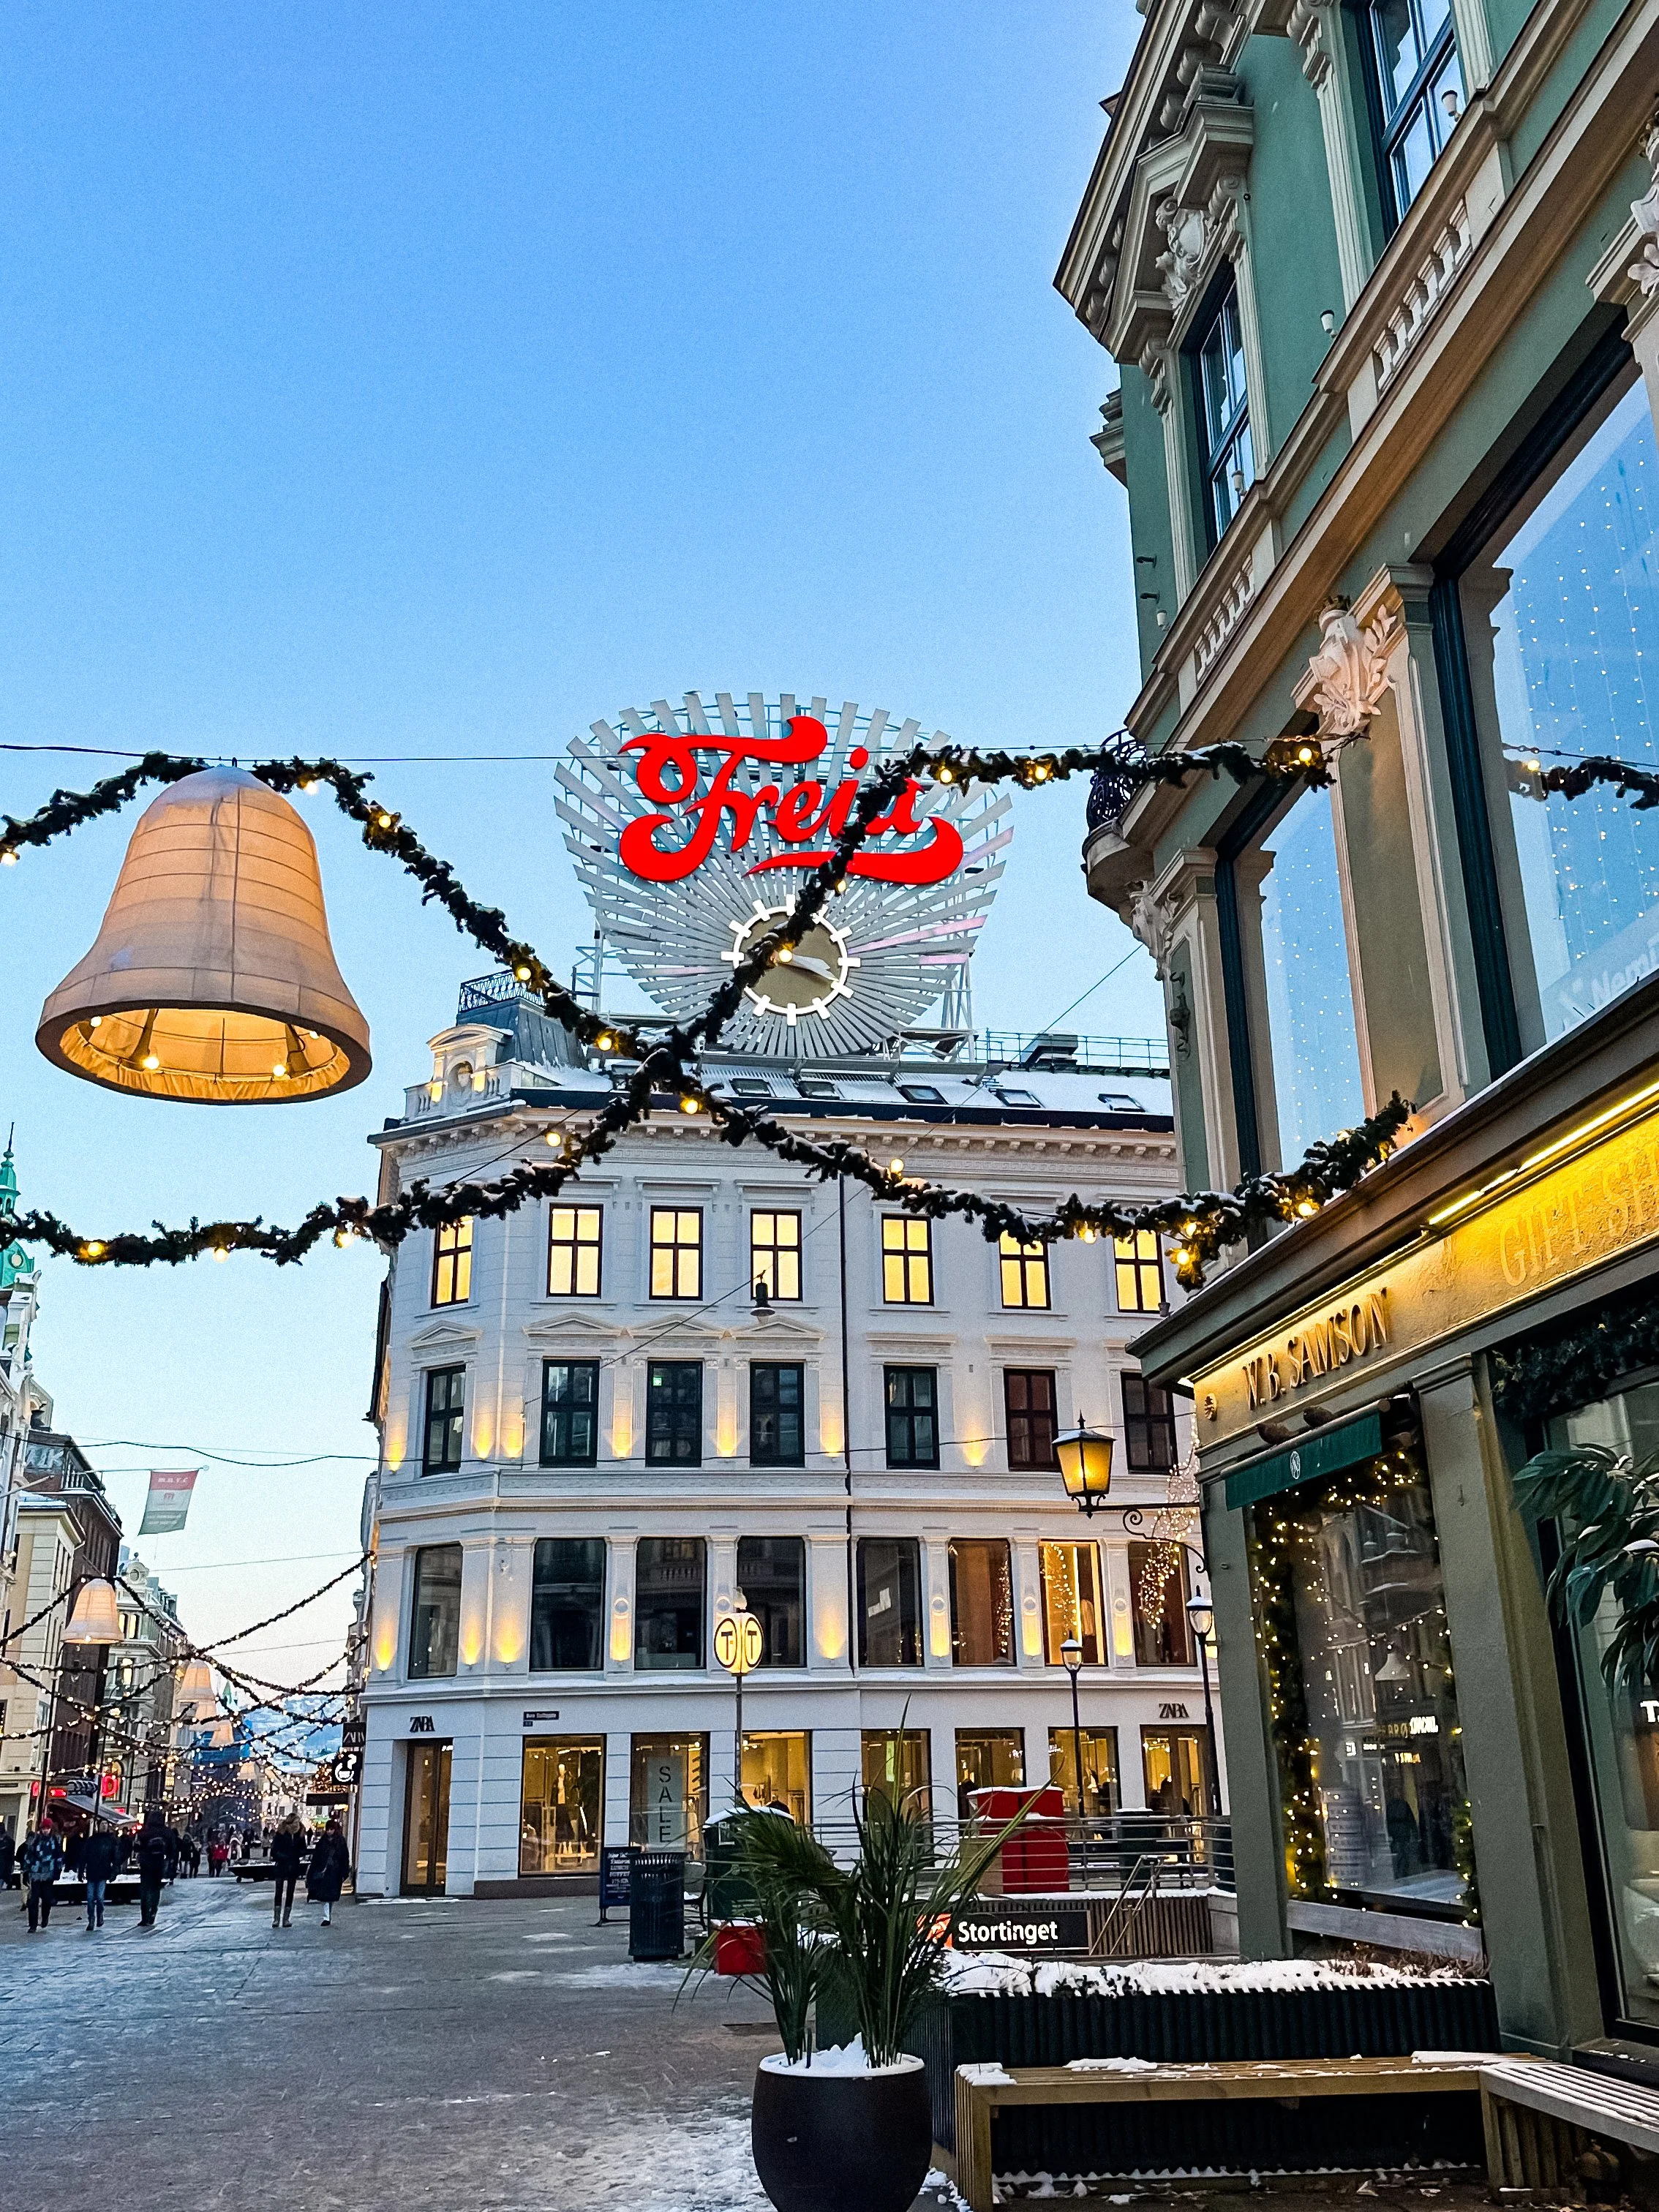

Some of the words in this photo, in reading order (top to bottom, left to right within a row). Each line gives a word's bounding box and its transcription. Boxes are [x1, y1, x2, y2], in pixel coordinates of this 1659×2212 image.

[1500, 1182, 1586, 1287] GIFT
[1287, 1287, 1391, 1389] SAMSON
[410, 1716, 435, 1732] ZARA
[1159, 1703, 1189, 1718] ZARA
[659, 1766, 672, 1843] SALE
[958, 1920, 1058, 1945] Stortinget
